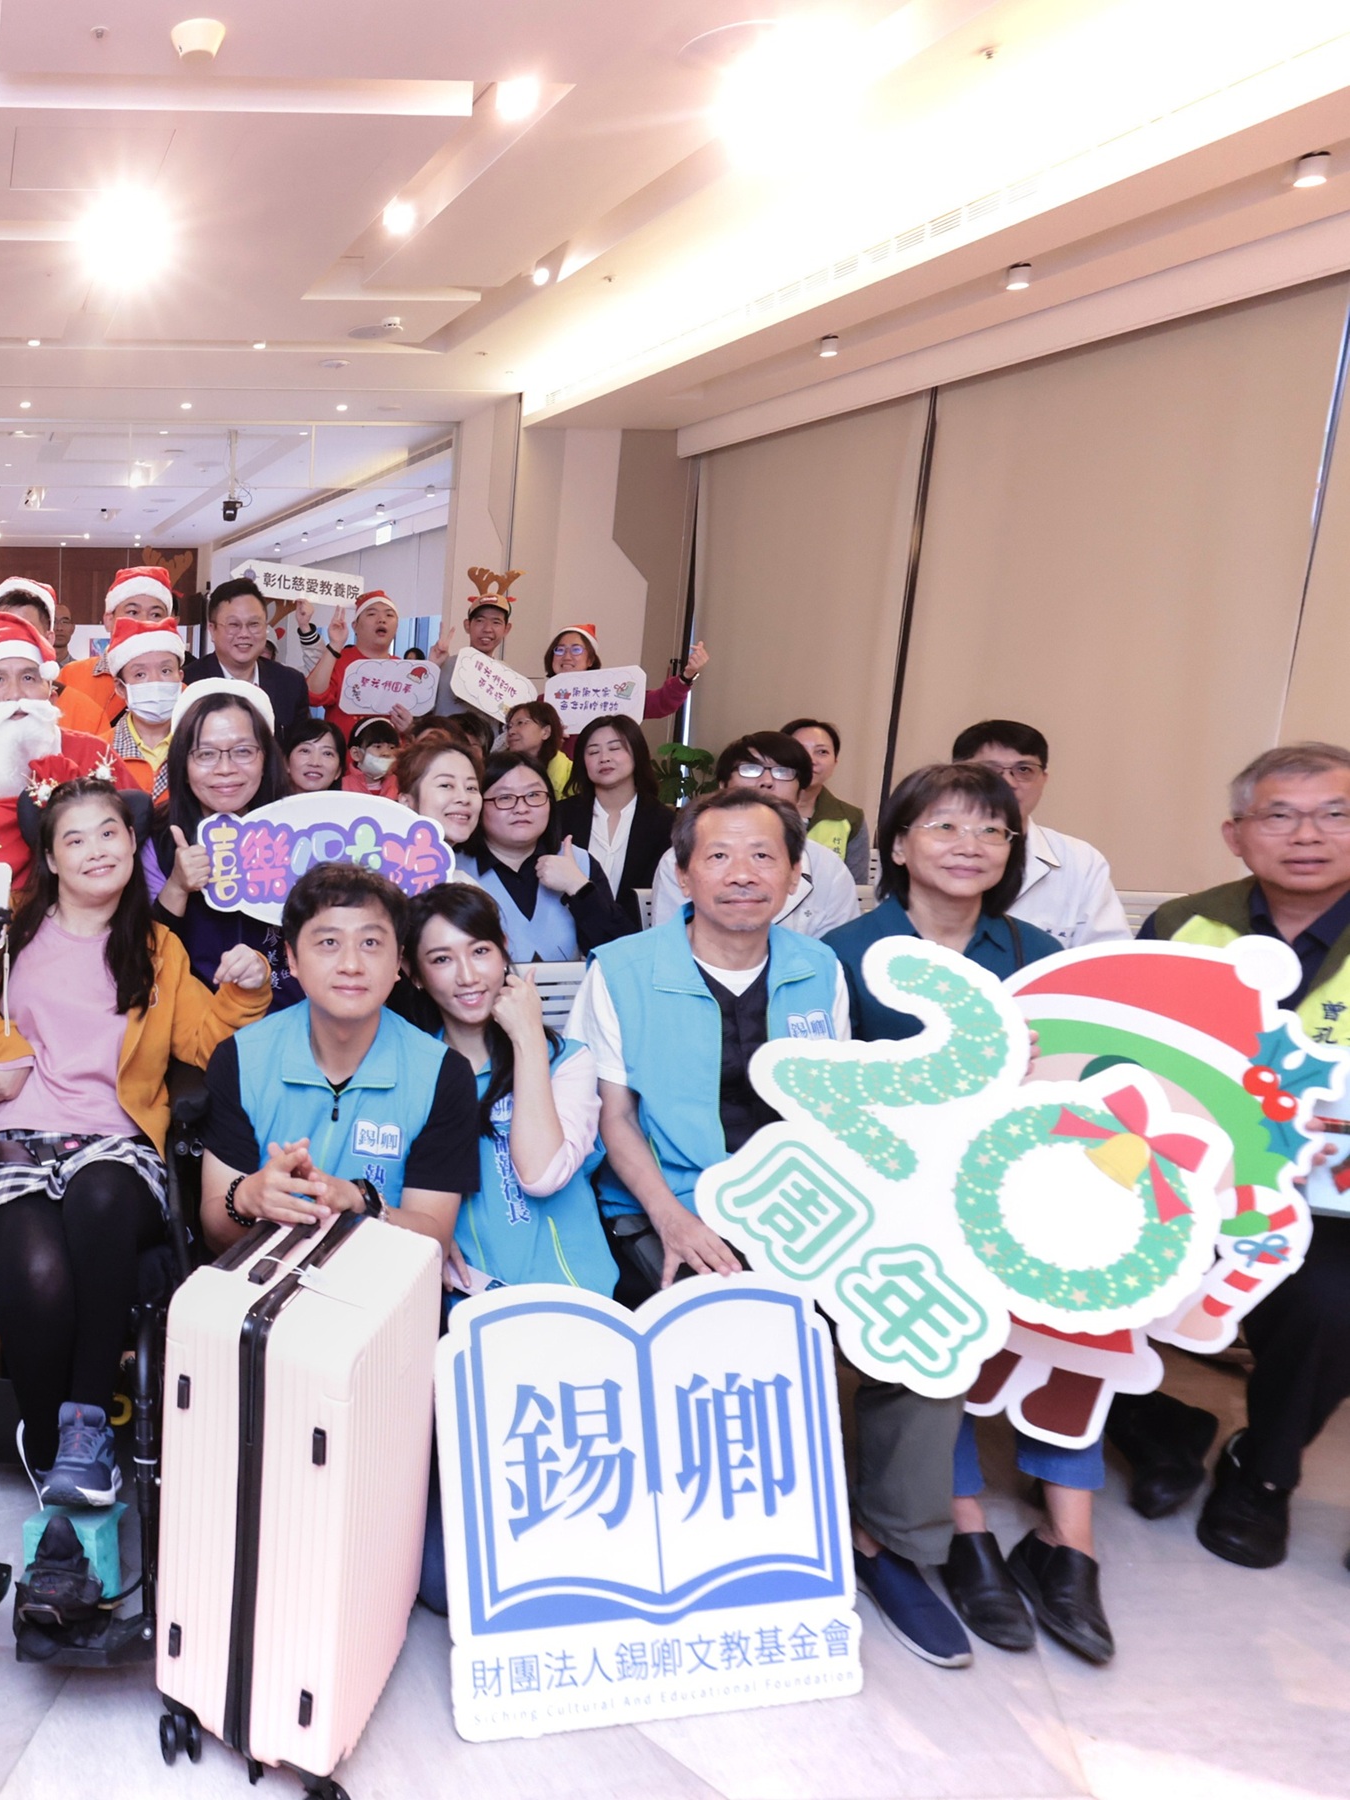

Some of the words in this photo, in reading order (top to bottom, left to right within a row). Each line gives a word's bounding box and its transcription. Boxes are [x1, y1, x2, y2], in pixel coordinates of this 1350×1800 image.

[263, 572, 361, 600] 彰化慈愛教養院
[358, 1128, 398, 1150] 錫卿
[733, 1150, 980, 1370] 周年
[502, 1372, 797, 1542] 錫卿
[472, 1619, 852, 1698] 財團法人錫卿文教基金會
[546, 1698, 614, 1717] Cultural
[623, 1694, 651, 1706] And
[660, 1680, 756, 1703] Educational
[765, 1670, 854, 1689] Foundation
